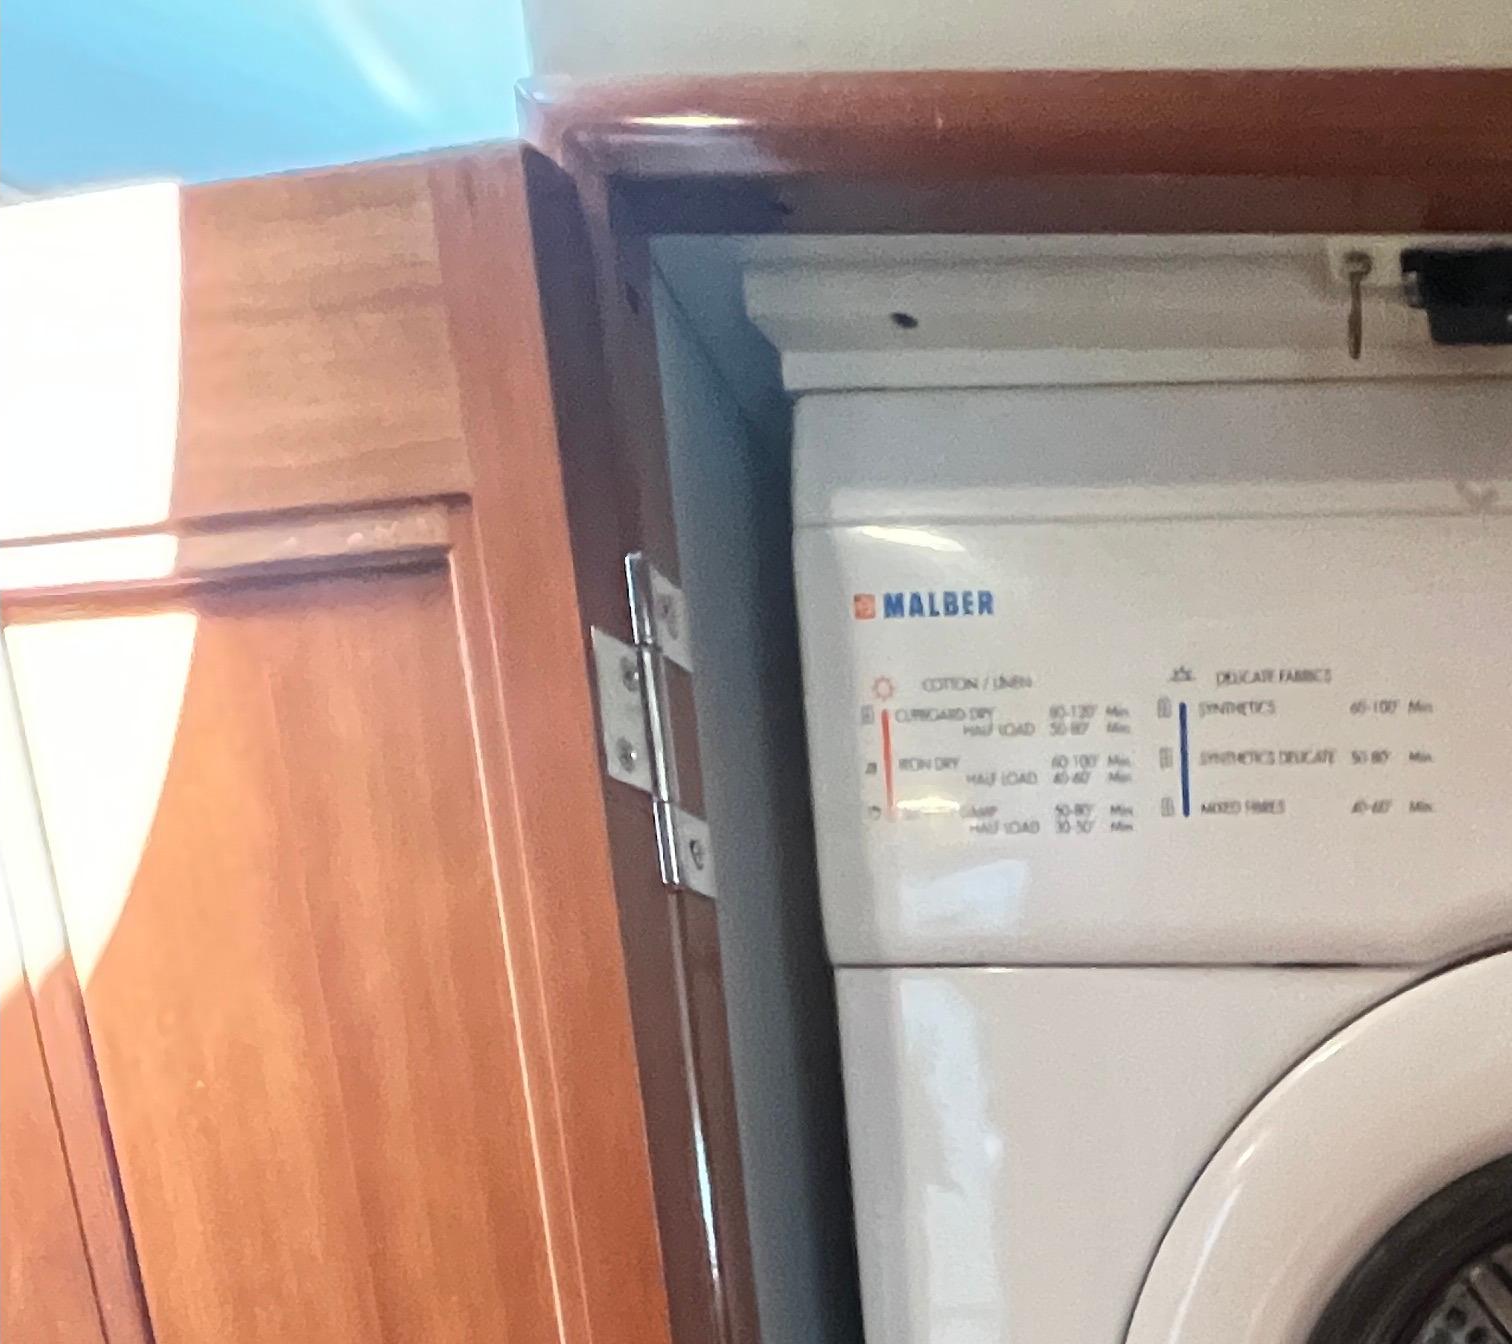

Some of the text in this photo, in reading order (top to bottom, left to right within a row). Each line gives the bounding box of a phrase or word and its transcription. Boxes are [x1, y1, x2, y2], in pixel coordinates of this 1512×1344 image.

[883, 590, 994, 619] MALBER
[922, 677, 979, 693] COTTON
[1001, 772, 1038, 786] LOAD
